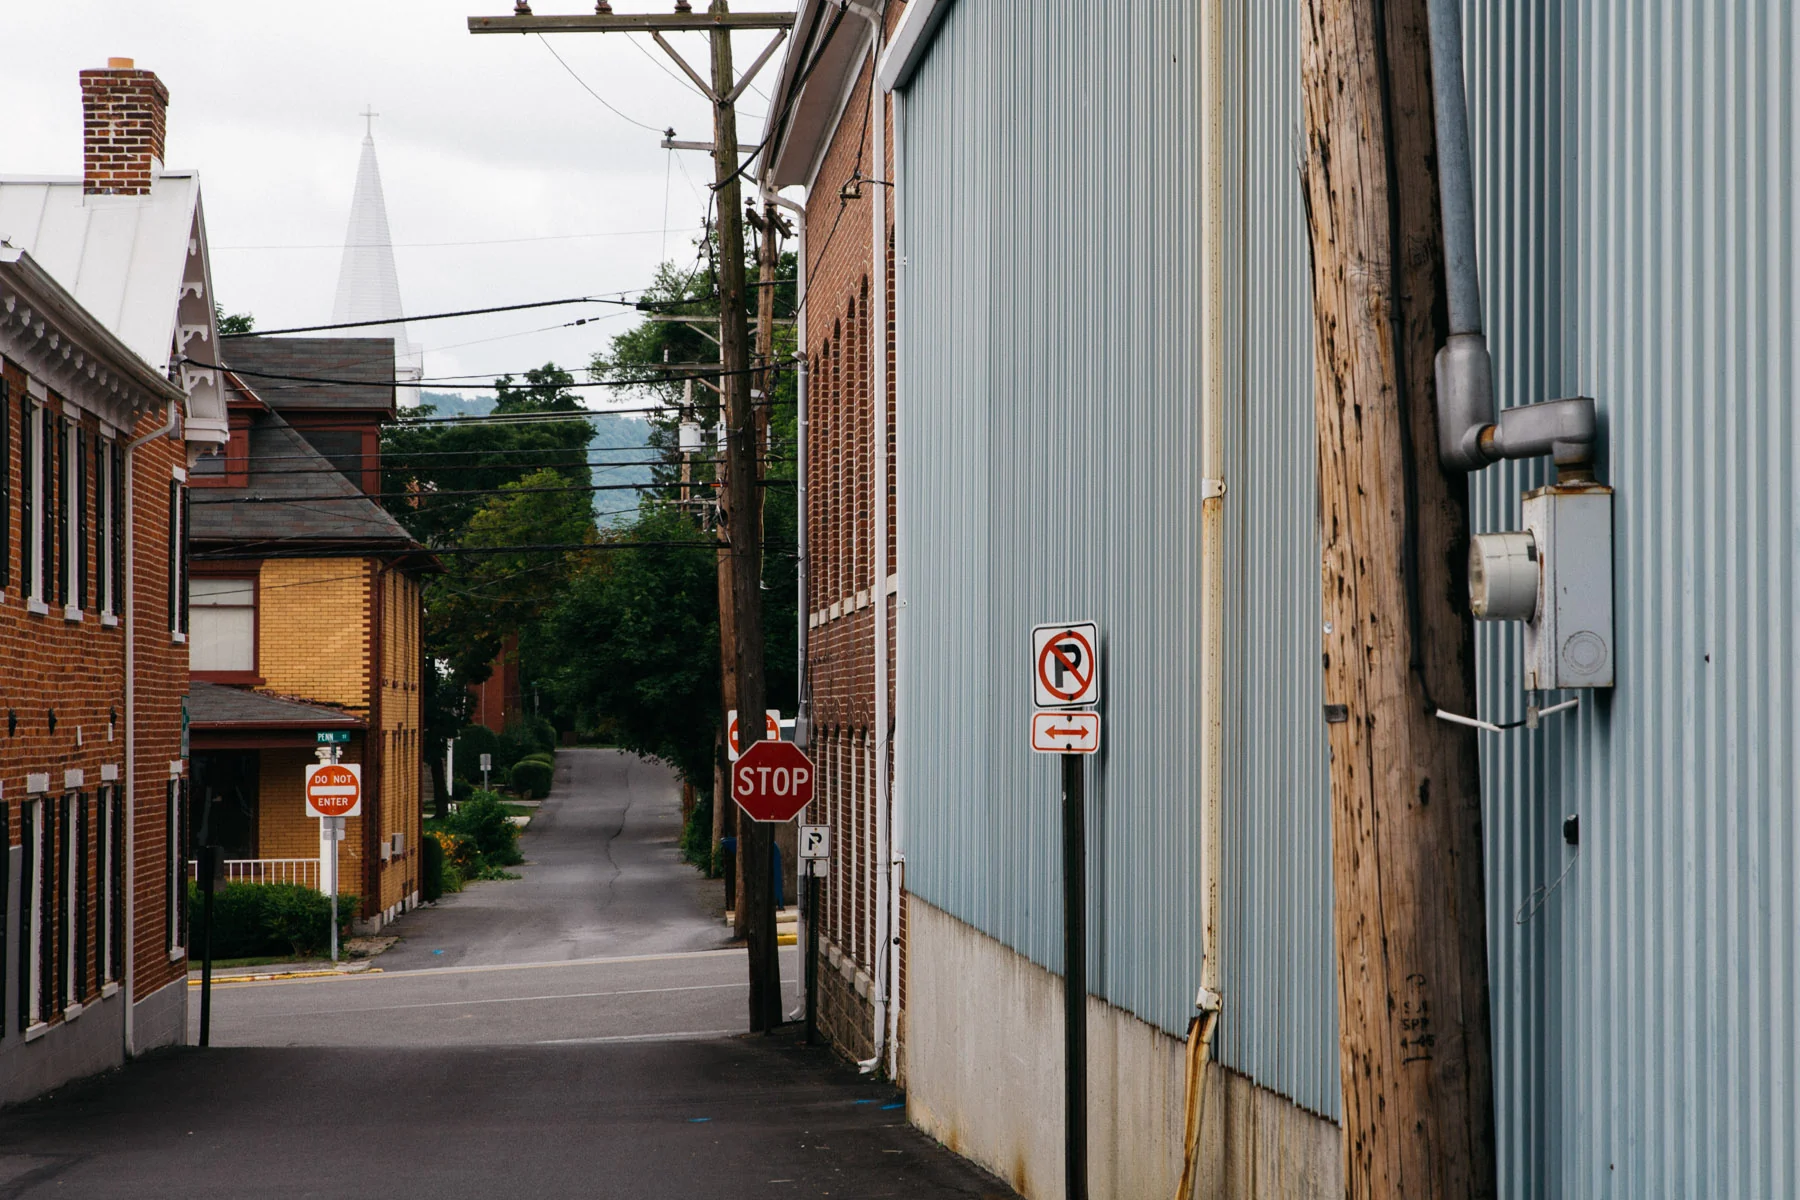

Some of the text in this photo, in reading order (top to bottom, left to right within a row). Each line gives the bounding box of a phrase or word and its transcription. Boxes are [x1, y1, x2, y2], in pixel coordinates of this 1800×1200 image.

[317, 733, 334, 742] PENN
[314, 774, 352, 784] DO NOT
[737, 766, 809, 796] STOP
[318, 797, 348, 807] ENTER
